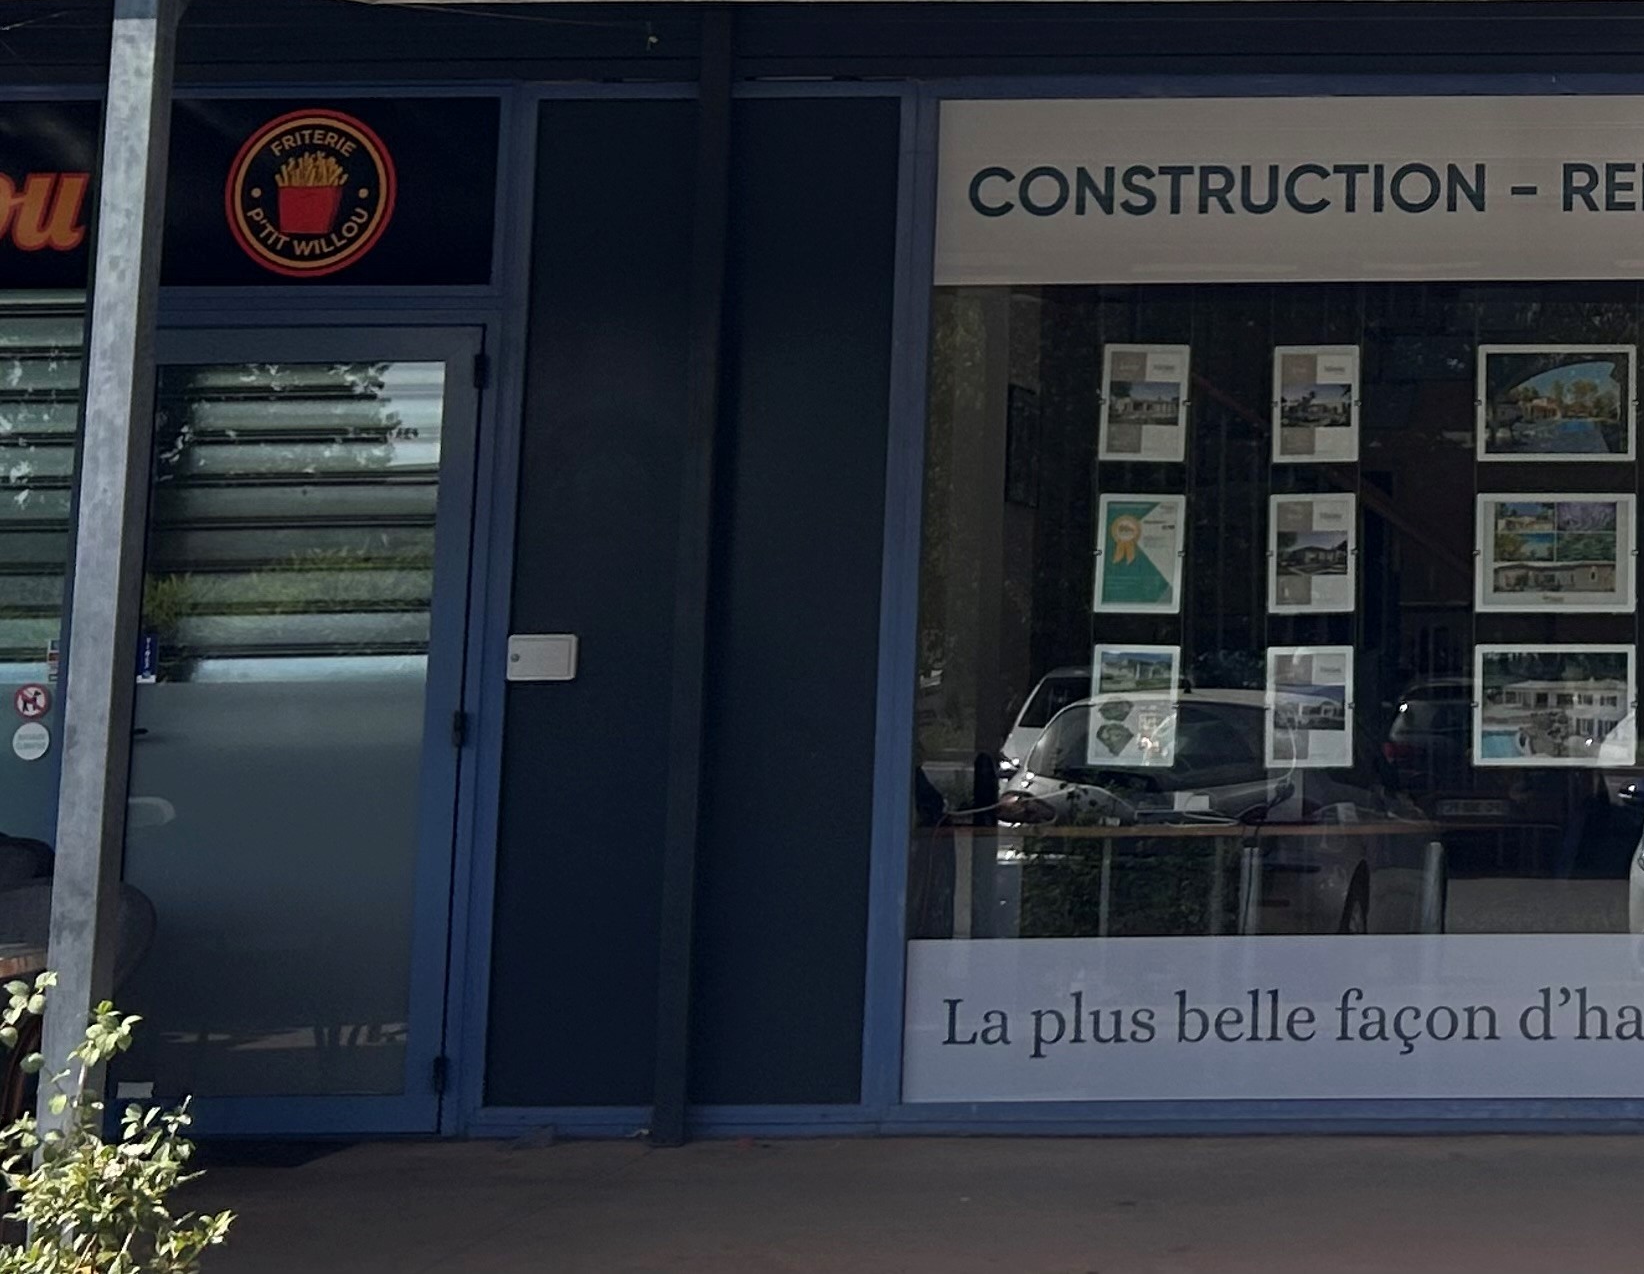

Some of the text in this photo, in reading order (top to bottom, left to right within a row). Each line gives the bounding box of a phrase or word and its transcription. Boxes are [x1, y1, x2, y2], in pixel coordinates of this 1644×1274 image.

[270, 129, 357, 157] FRITERIE
[968, 162, 1486, 216] CONSTRUCTION
[247, 207, 368, 256] P'TIT WILLOU
[942, 998, 1012, 1045] La
[1029, 991, 1156, 1058] plus
[1174, 989, 1316, 1043] belle
[1335, 988, 1499, 1054] façon
